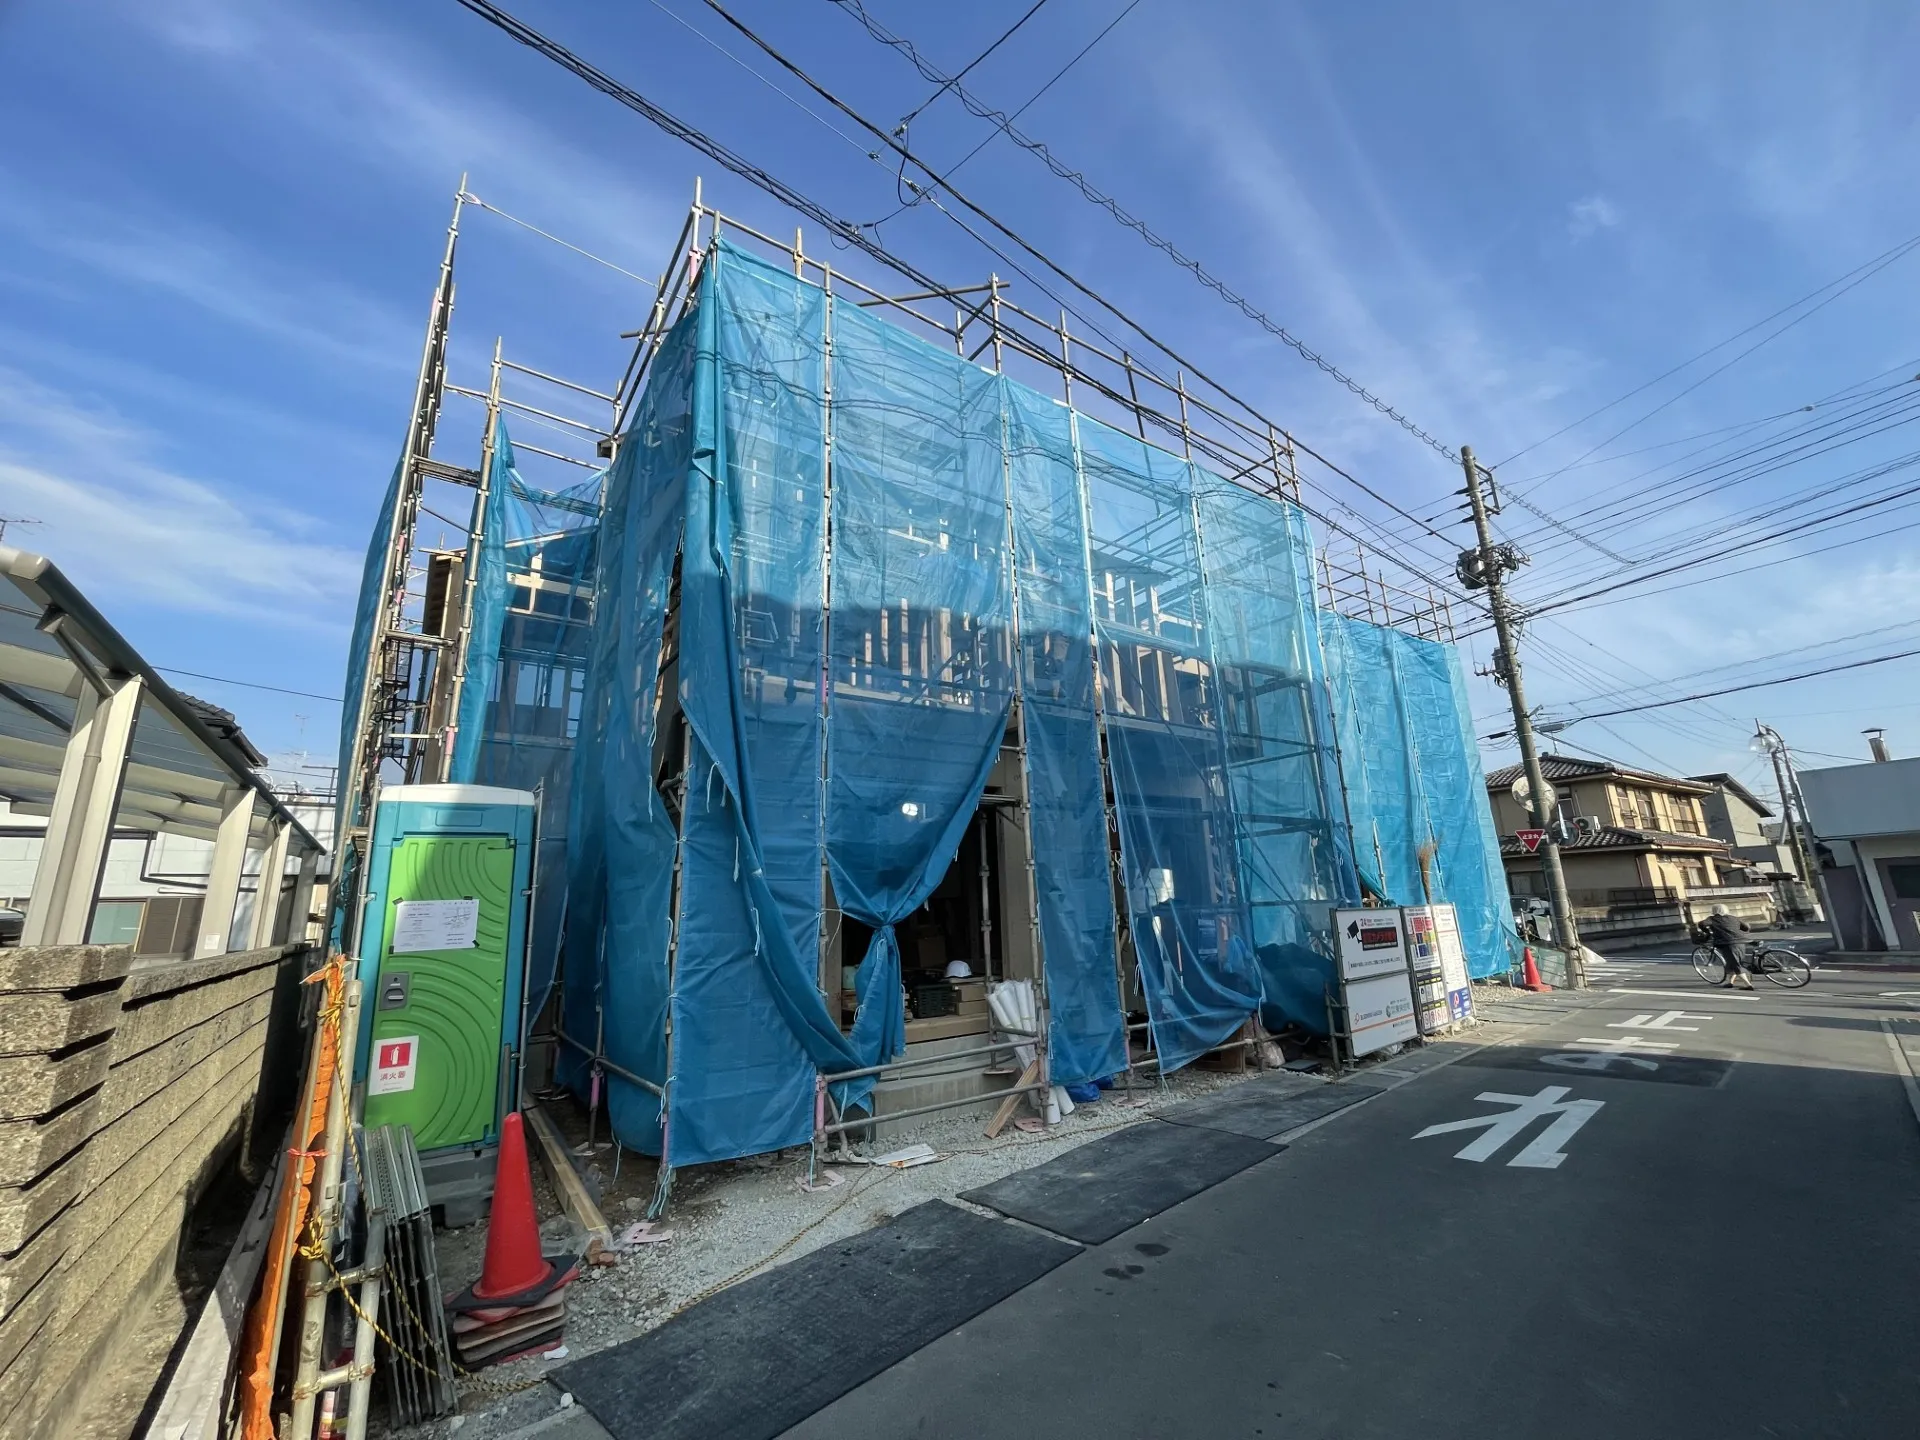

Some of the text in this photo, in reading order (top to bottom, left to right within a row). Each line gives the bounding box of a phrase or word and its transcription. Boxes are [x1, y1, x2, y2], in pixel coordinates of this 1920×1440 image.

[380, 1070, 406, 1081] 消火器
[1410, 1011, 1713, 1168] 止まれ
